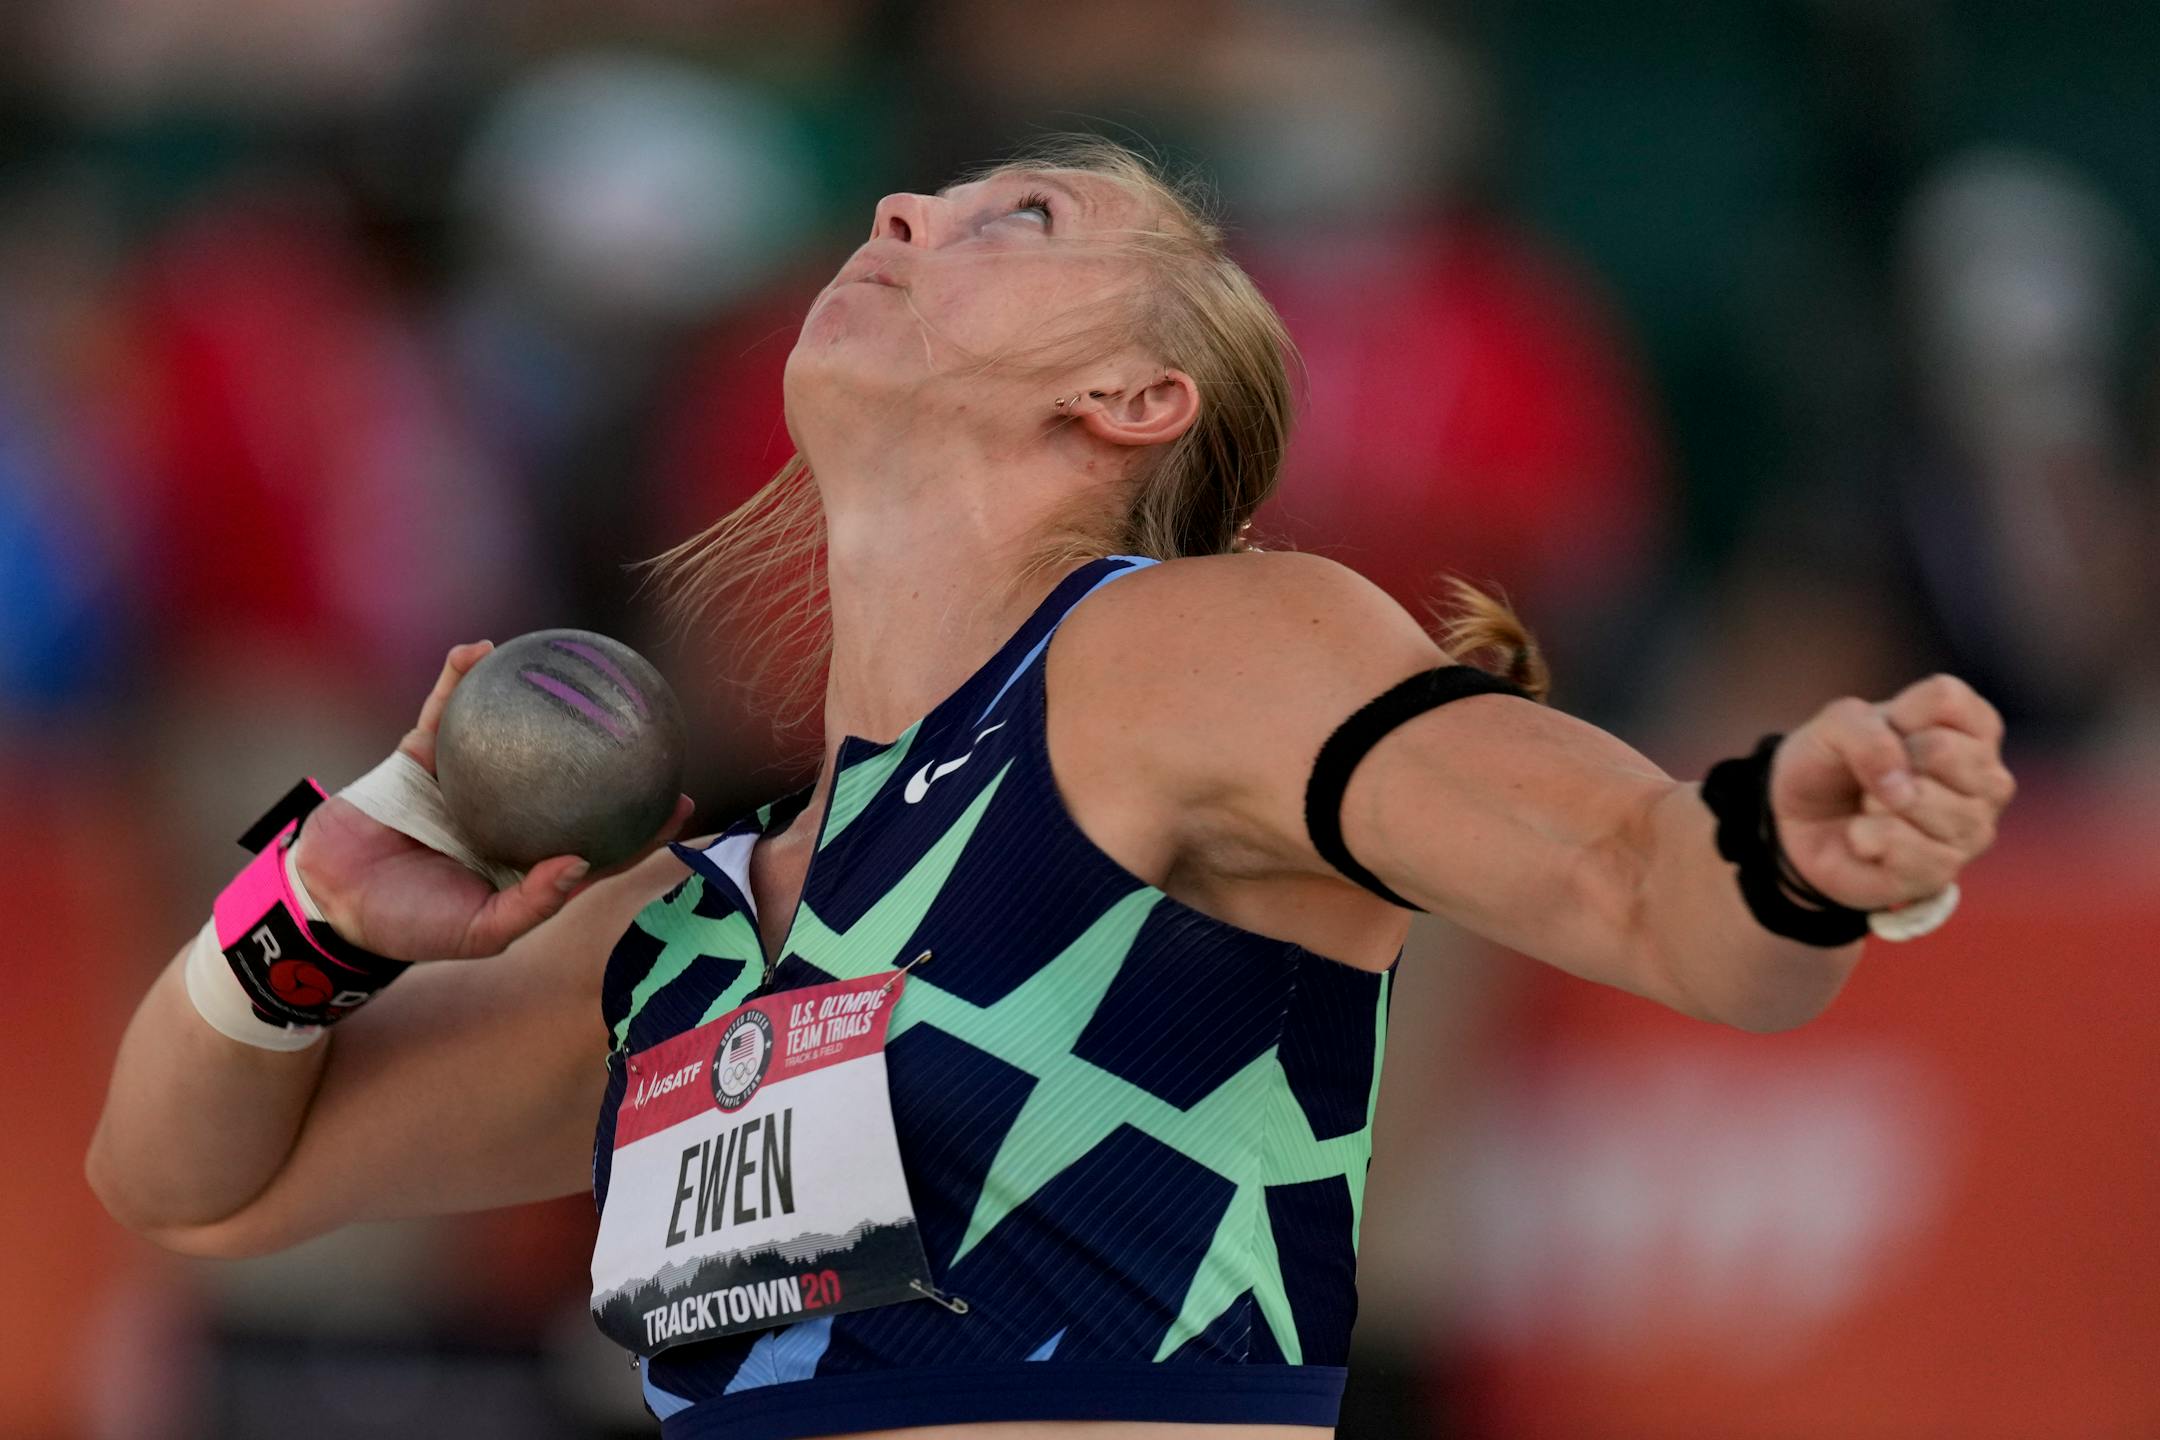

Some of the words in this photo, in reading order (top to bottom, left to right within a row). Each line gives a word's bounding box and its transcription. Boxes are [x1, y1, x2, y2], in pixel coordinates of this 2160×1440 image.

[789, 999, 815, 1030] U.S.
[818, 988, 888, 1020] OLYMPIC
[720, 1014, 746, 1048] UNITED
[746, 1010, 770, 1031] STATES
[786, 1021, 825, 1057] TEAM
[824, 1010, 875, 1045] TRIALS
[784, 1053, 811, 1069] TRACK
[820, 1042, 844, 1057] FIELD
[652, 1060, 704, 1099] USATF
[715, 1088, 741, 1107] OLYMPIC
[742, 1074, 762, 1100] TEAM
[665, 1107, 796, 1249] EWEN
